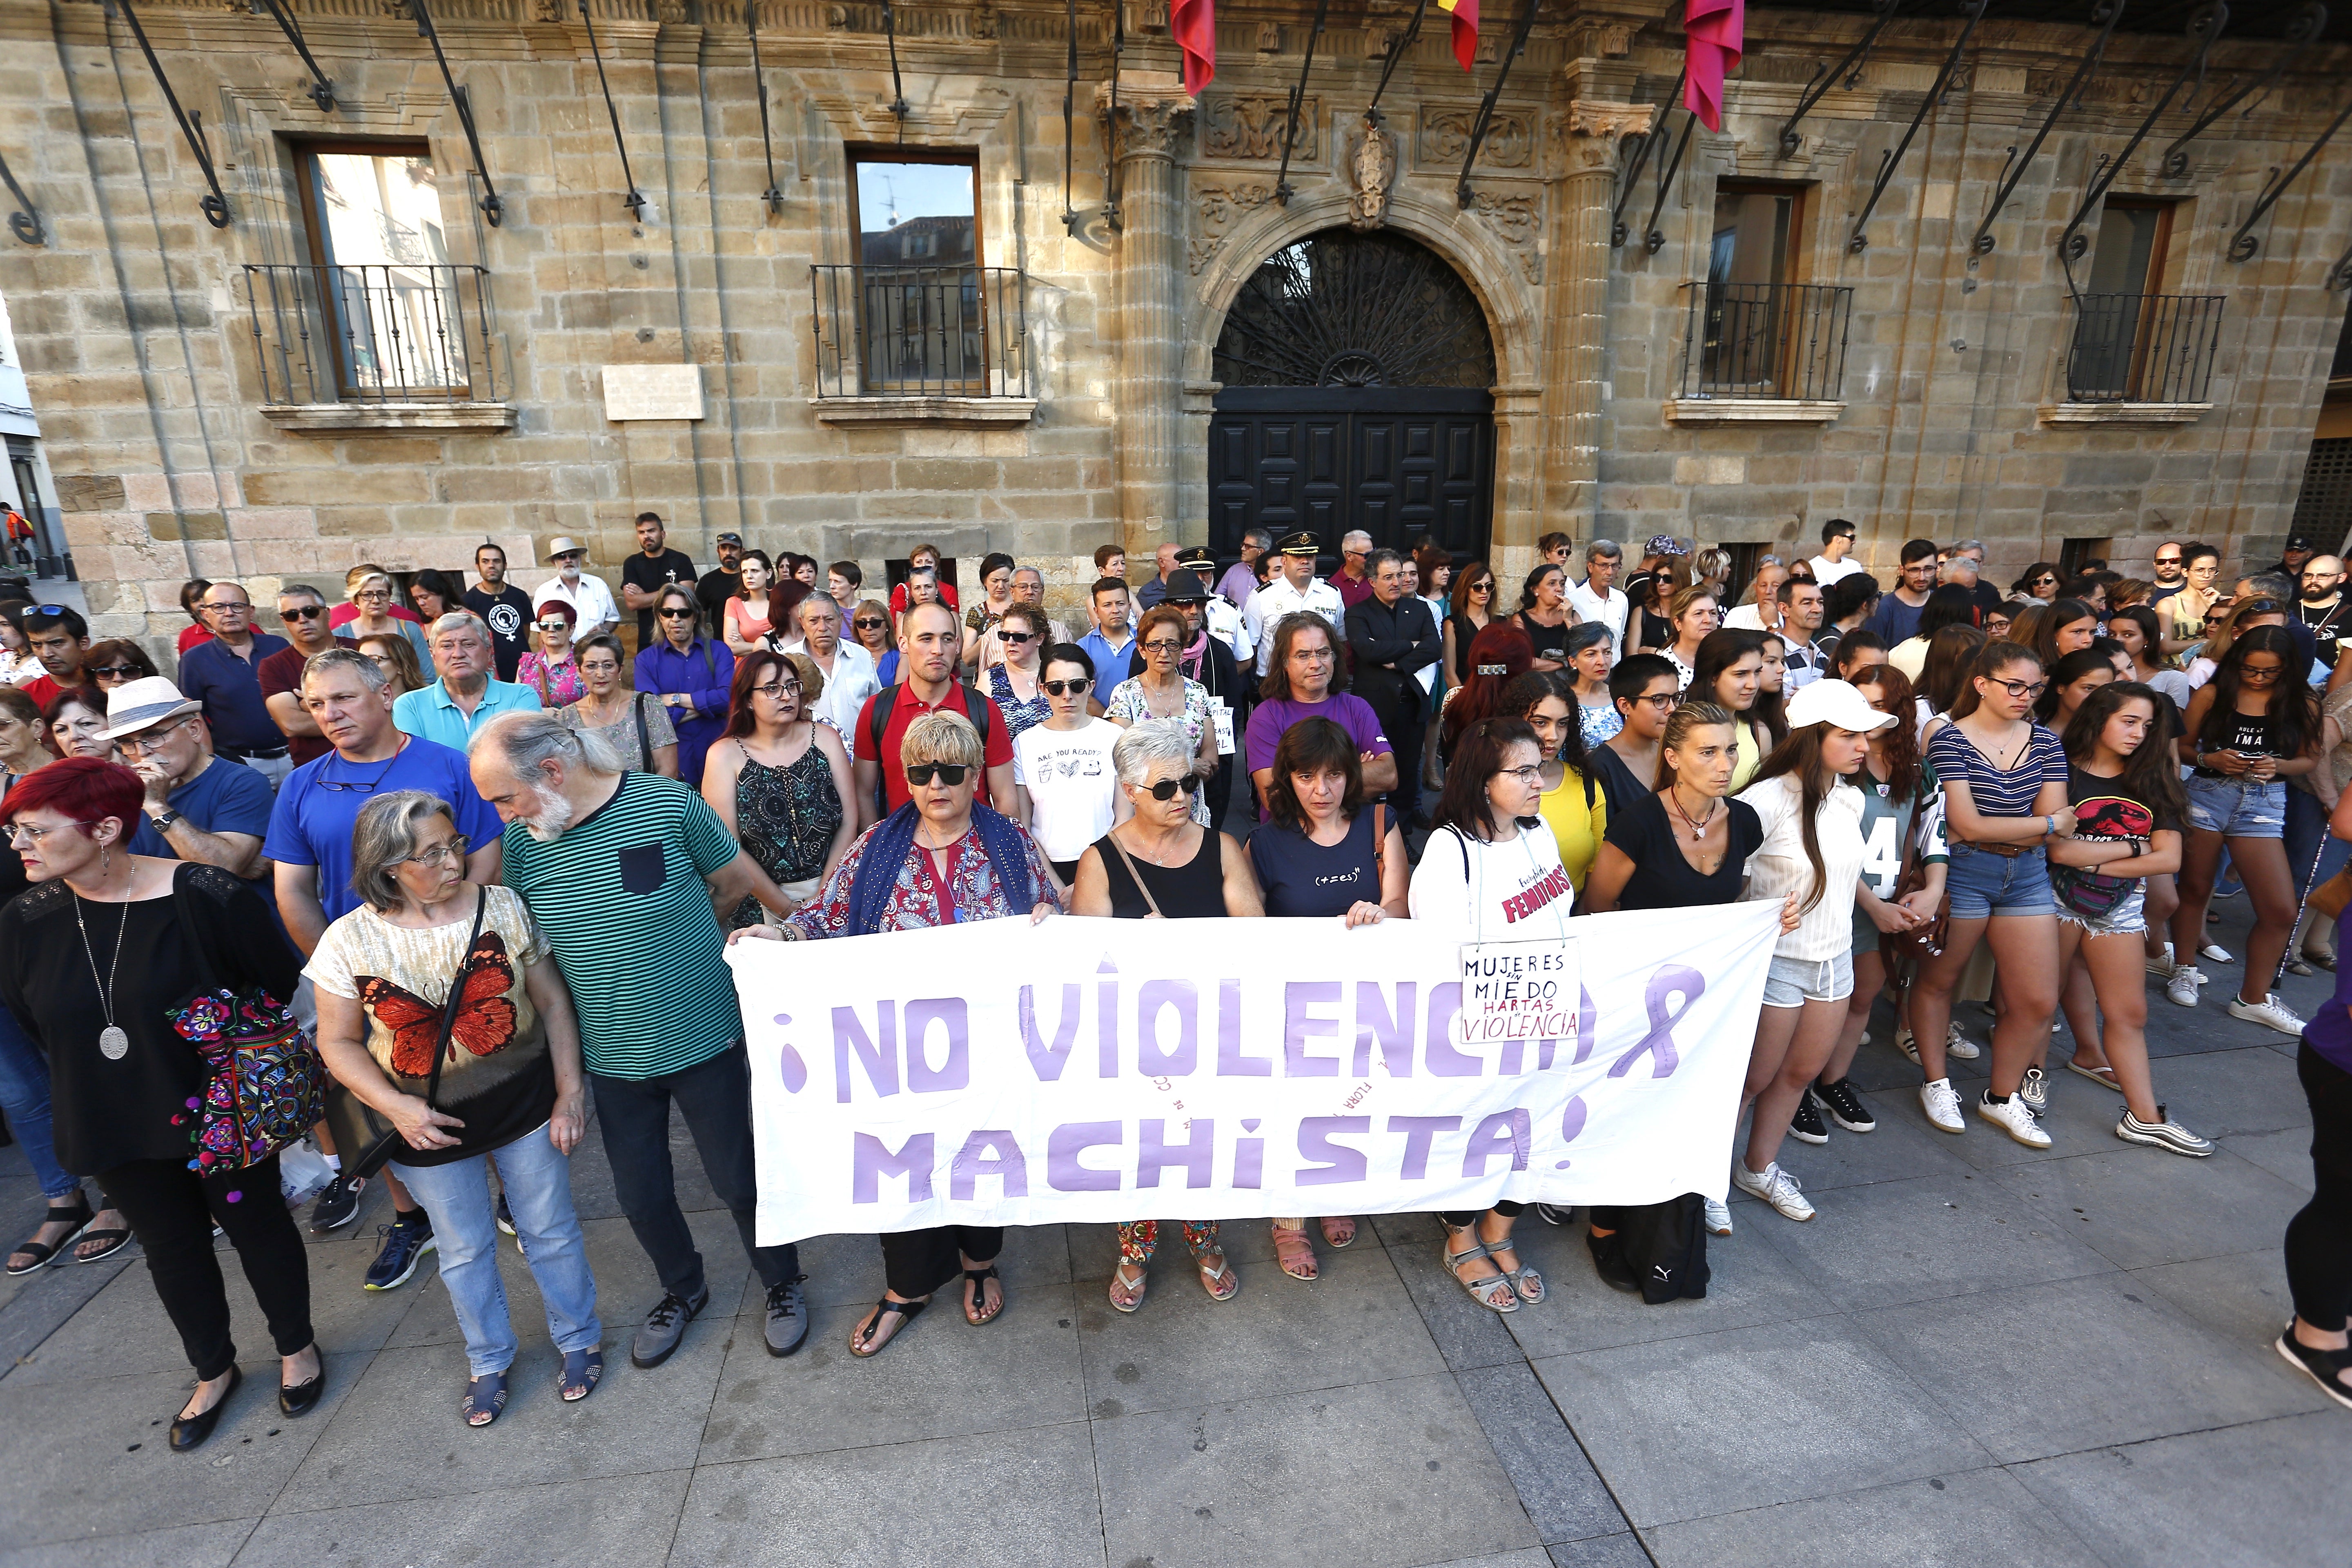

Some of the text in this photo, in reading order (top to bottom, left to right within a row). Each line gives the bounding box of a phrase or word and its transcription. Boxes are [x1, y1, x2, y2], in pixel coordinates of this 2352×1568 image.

[491, 606, 516, 619] GOOD NIGHT
[2254, 736, 2262, 745] A
[1038, 753, 1053, 762] ARE
[1863, 817, 1902, 898] 4
[1465, 955, 1563, 977] MUJERES
[1484, 999, 1553, 1014] HARTAS
[1343, 1082, 1372, 1109] FLORA
[1173, 1100, 1184, 1110] DE
